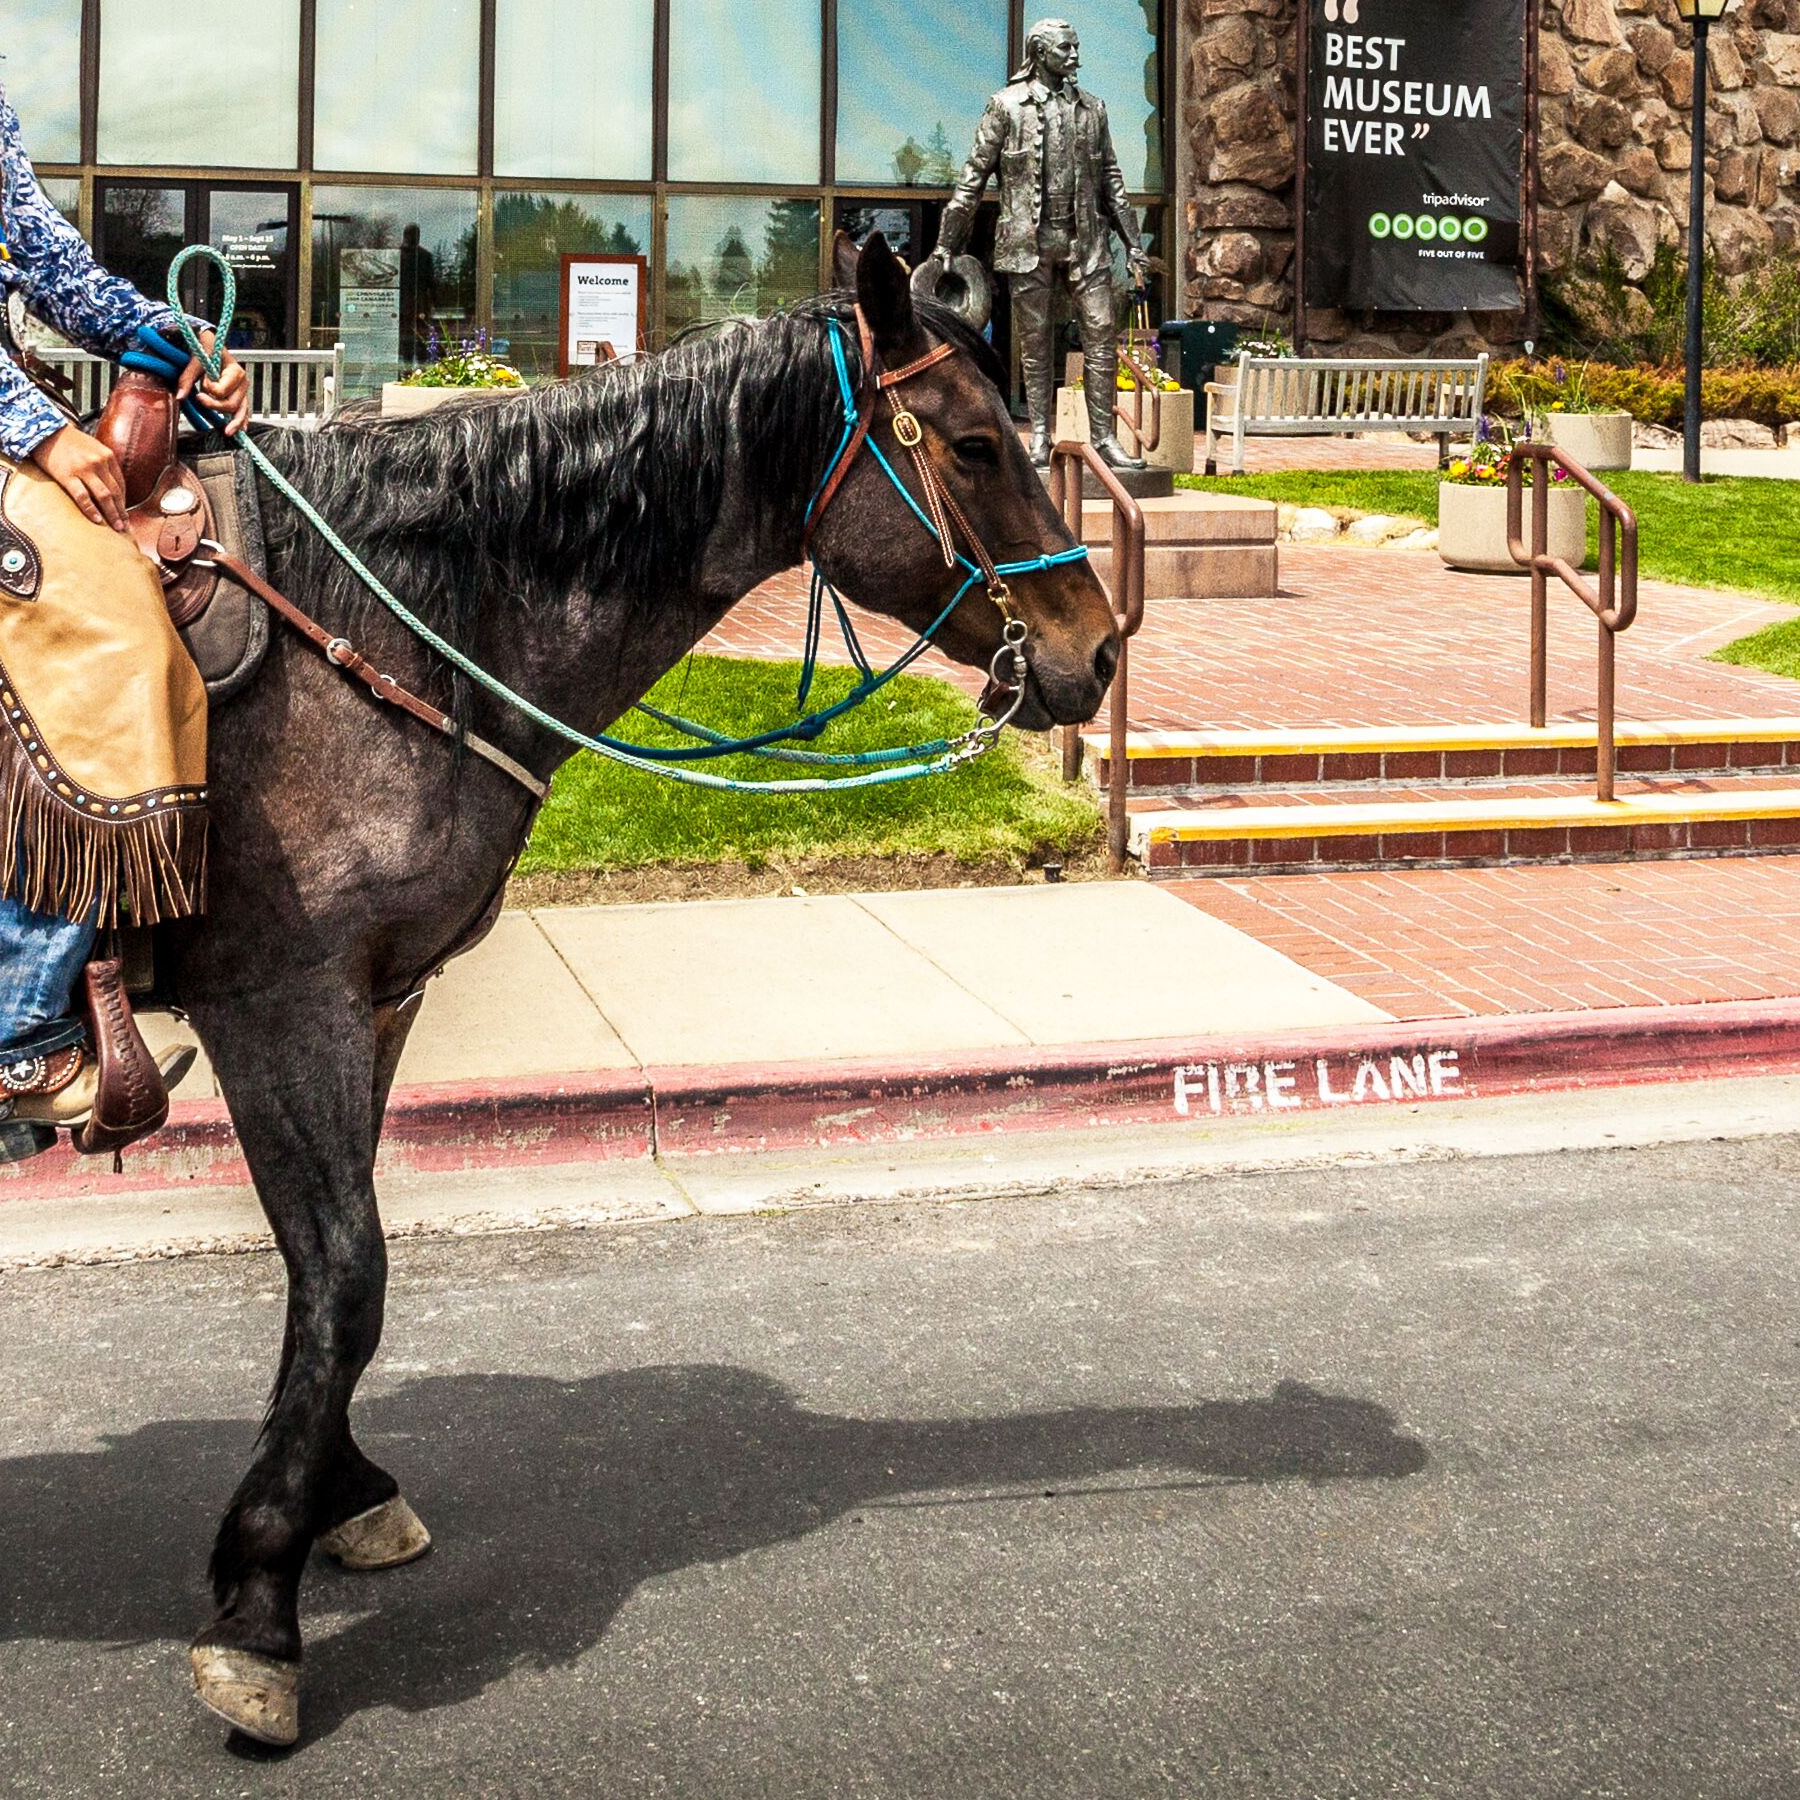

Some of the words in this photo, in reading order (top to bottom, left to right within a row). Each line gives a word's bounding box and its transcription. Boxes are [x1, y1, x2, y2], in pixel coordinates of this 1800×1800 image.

[1325, 32, 1406, 71] BEST
[1323, 75, 1492, 119] MUSEUM
[1418, 249, 1435, 257] FIVE
[1436, 250, 1453, 258] OUT
[1454, 250, 1465, 259] OF
[1466, 251, 1484, 259] FIVE
[577, 276, 629, 286] Welcome
[1173, 1059, 1301, 1114] FIRE
[1316, 1051, 1465, 1103] LANE
